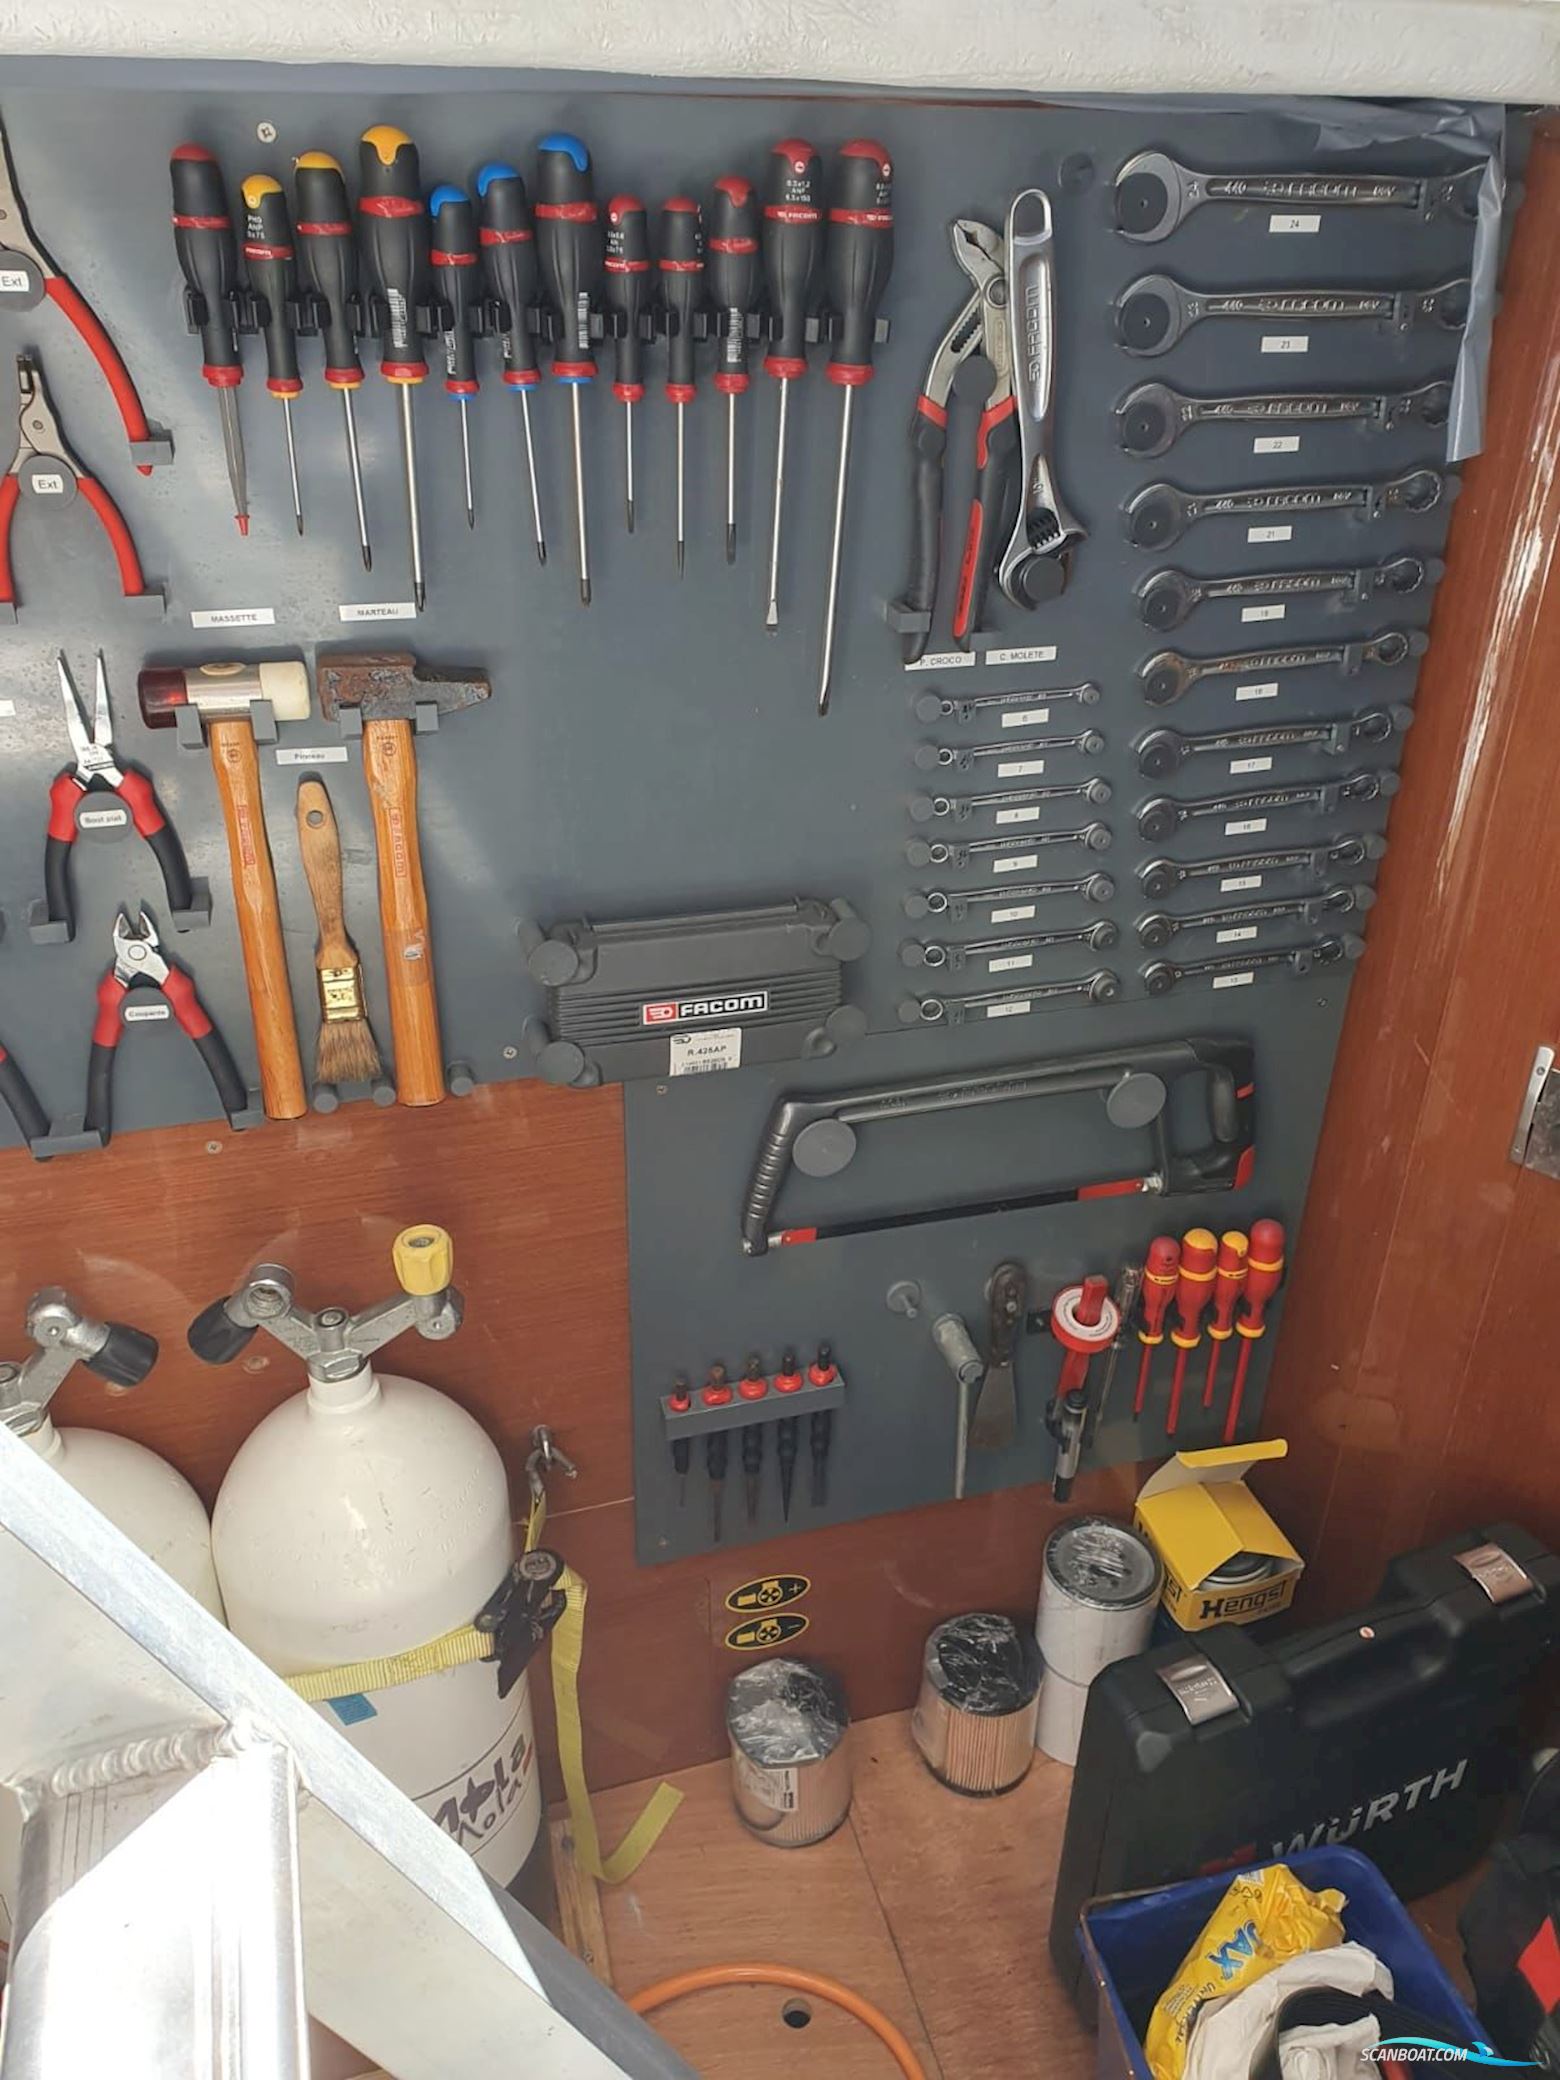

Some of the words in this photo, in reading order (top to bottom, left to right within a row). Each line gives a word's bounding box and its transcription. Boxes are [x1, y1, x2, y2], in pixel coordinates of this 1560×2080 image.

[1290, 220, 1300, 229] 24
[2, 273, 23, 288] Ext
[1025, 285, 1041, 356] FACOM
[1272, 441, 1283, 449] 22
[38, 479, 58, 490] Ext
[1266, 531, 1276, 539] 21
[356, 608, 399, 617] MARTEAU
[211, 613, 257, 623] MASSETTE
[930, 655, 963, 666] CROCO
[1010, 651, 1044, 661] MOLETE
[680, 996, 763, 1017] FACOM
[1004, 1006, 1013, 1014] 12
[1199, 1579, 1288, 1620] Hengst
[1272, 1758, 1468, 1858] WÜRTH
